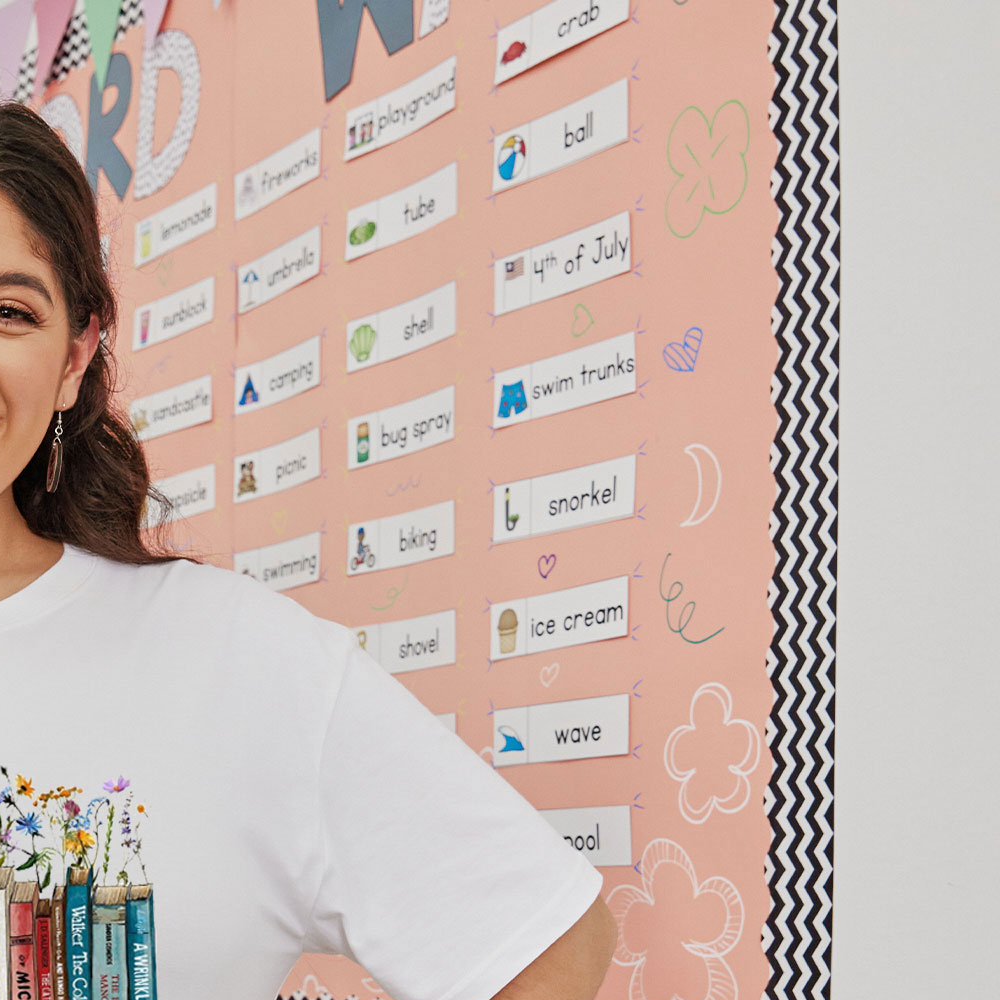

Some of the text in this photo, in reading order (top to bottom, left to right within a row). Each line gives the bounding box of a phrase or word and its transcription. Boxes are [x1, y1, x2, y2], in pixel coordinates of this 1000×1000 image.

[557, 0, 601, 38] crab
[378, 66, 457, 136] playground
[564, 111, 594, 149] ball
[261, 148, 318, 195] fireworks
[161, 200, 214, 241] lemonade
[404, 195, 436, 225] tube
[267, 247, 316, 287] umbrella
[533, 231, 629, 283] 4th of July
[162, 292, 208, 330] sunblock
[404, 306, 435, 341] shell
[269, 361, 314, 391] camping
[532, 351, 635, 400] swim trunks
[381, 411, 452, 449] bug spray
[276, 456, 307, 484] picnic
[548, 475, 617, 517] snorkel
[399, 528, 437, 552] biking
[263, 555, 317, 581] swimming
[530, 603, 624, 638] ice cream
[399, 628, 440, 659] shovel
[554, 722, 602, 745] wave
[71, 905, 87, 948] Walker
[72, 951, 88, 976] The
[132, 942, 149, 952] A
[41, 972, 50, 986] THE
[111, 974, 120, 993] THE
